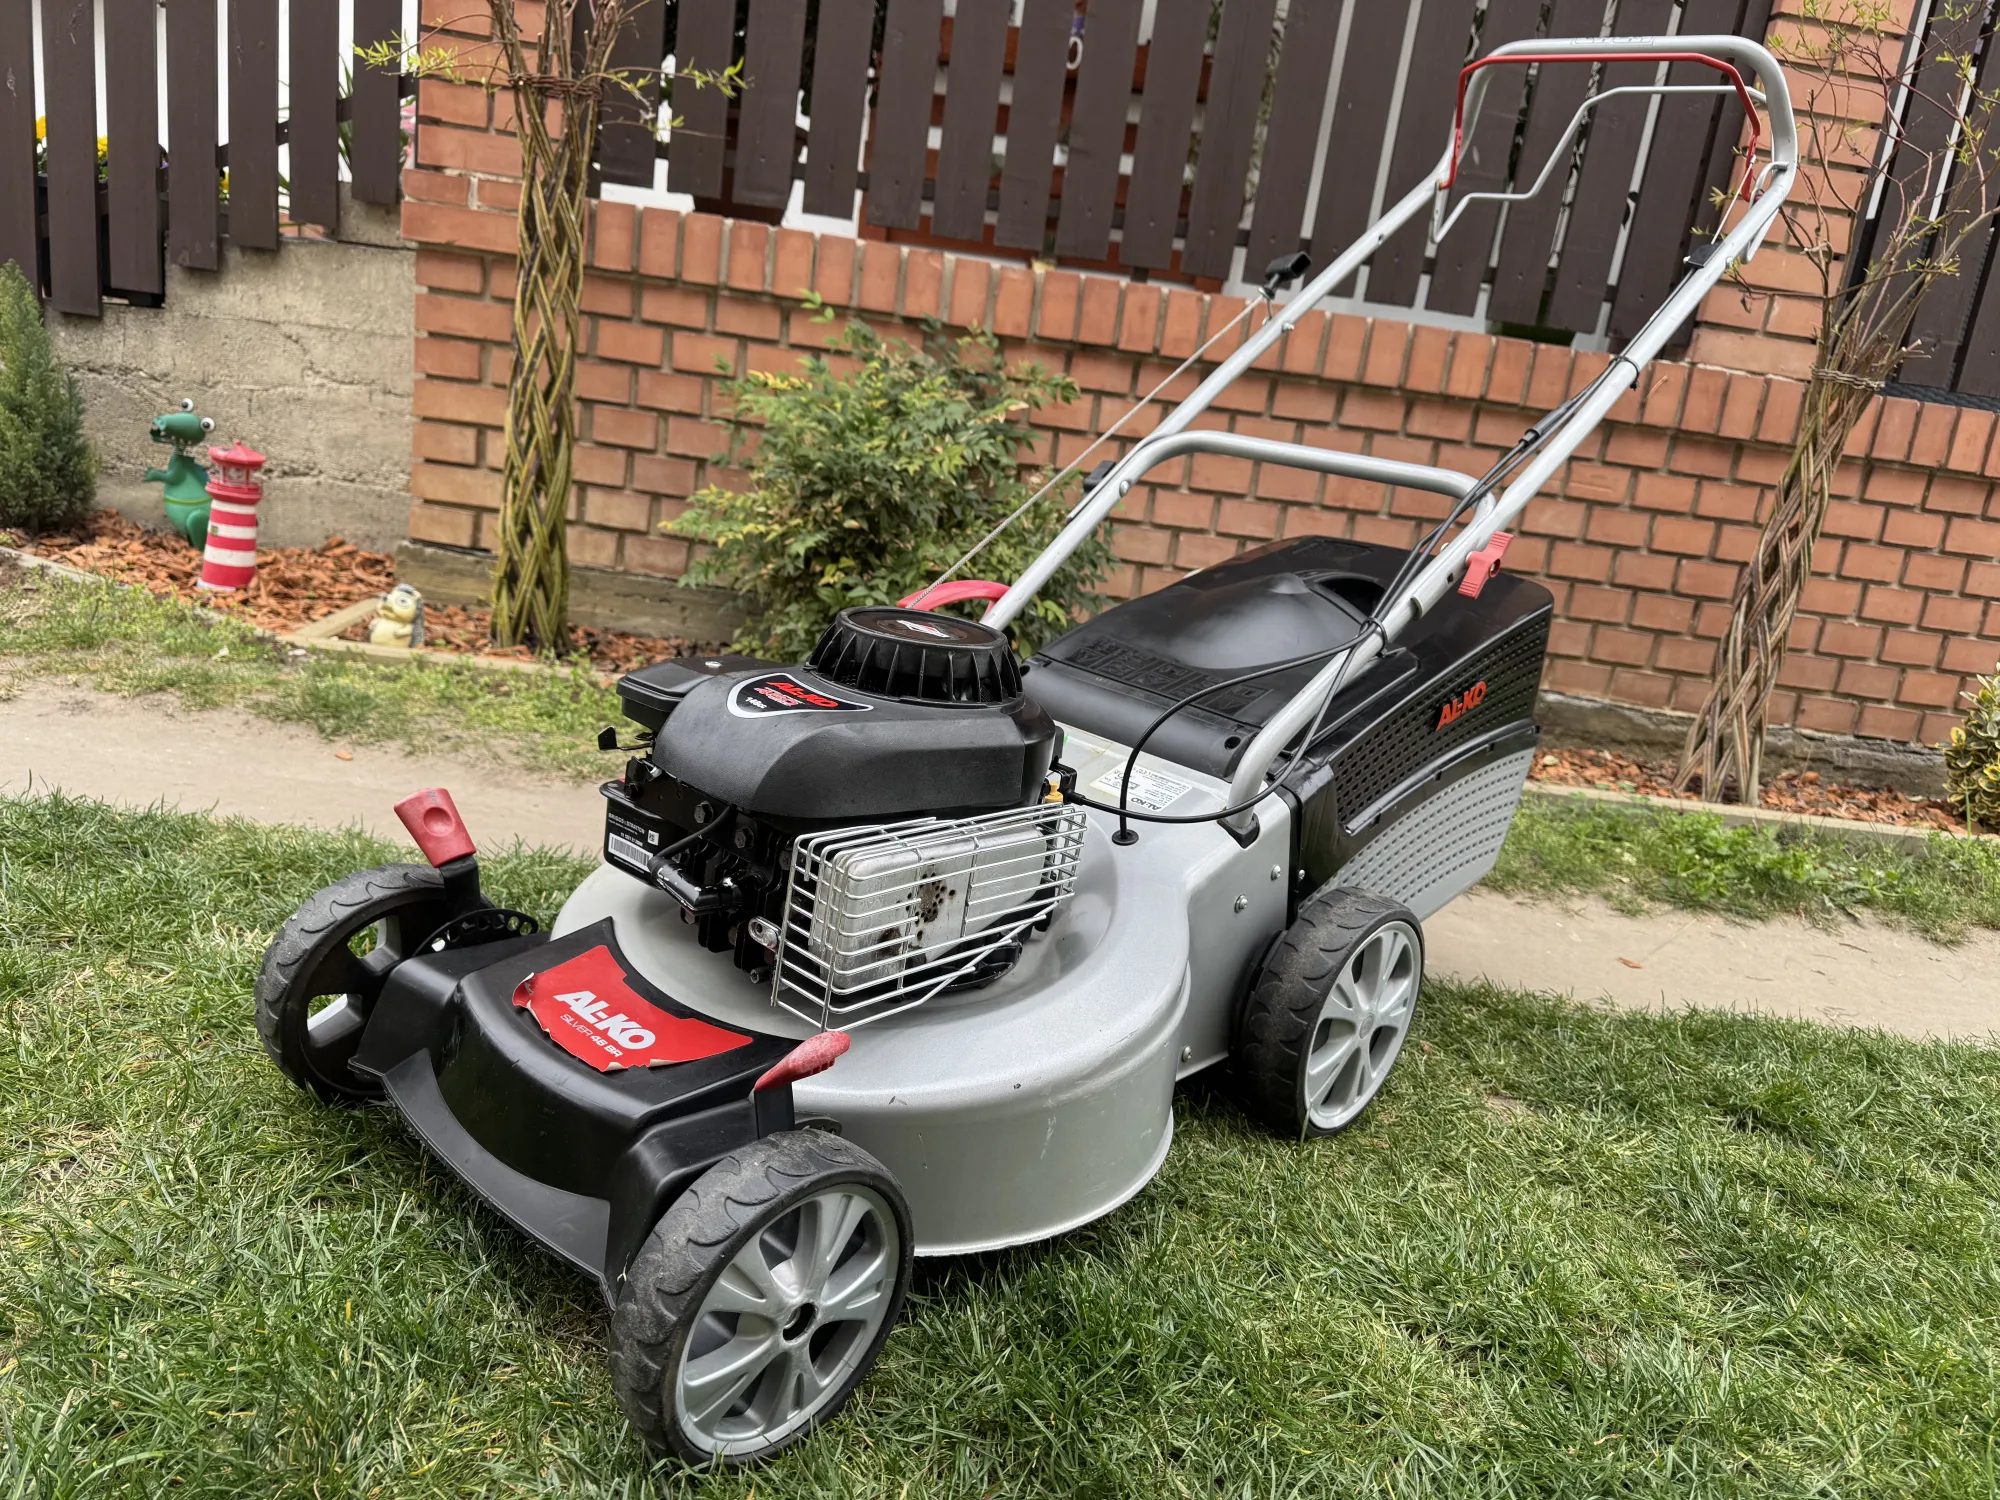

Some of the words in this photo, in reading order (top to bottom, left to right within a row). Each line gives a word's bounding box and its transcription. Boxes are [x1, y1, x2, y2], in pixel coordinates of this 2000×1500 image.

[766, 681, 839, 708] AL-KO
[1436, 681, 1487, 731] AL-KO
[1131, 797, 1162, 811] AL-KO
[553, 990, 656, 1050] AL-KO
[560, 1014, 594, 1036] SILVER
[590, 1035, 609, 1047] 46
[604, 1044, 624, 1058] BR
